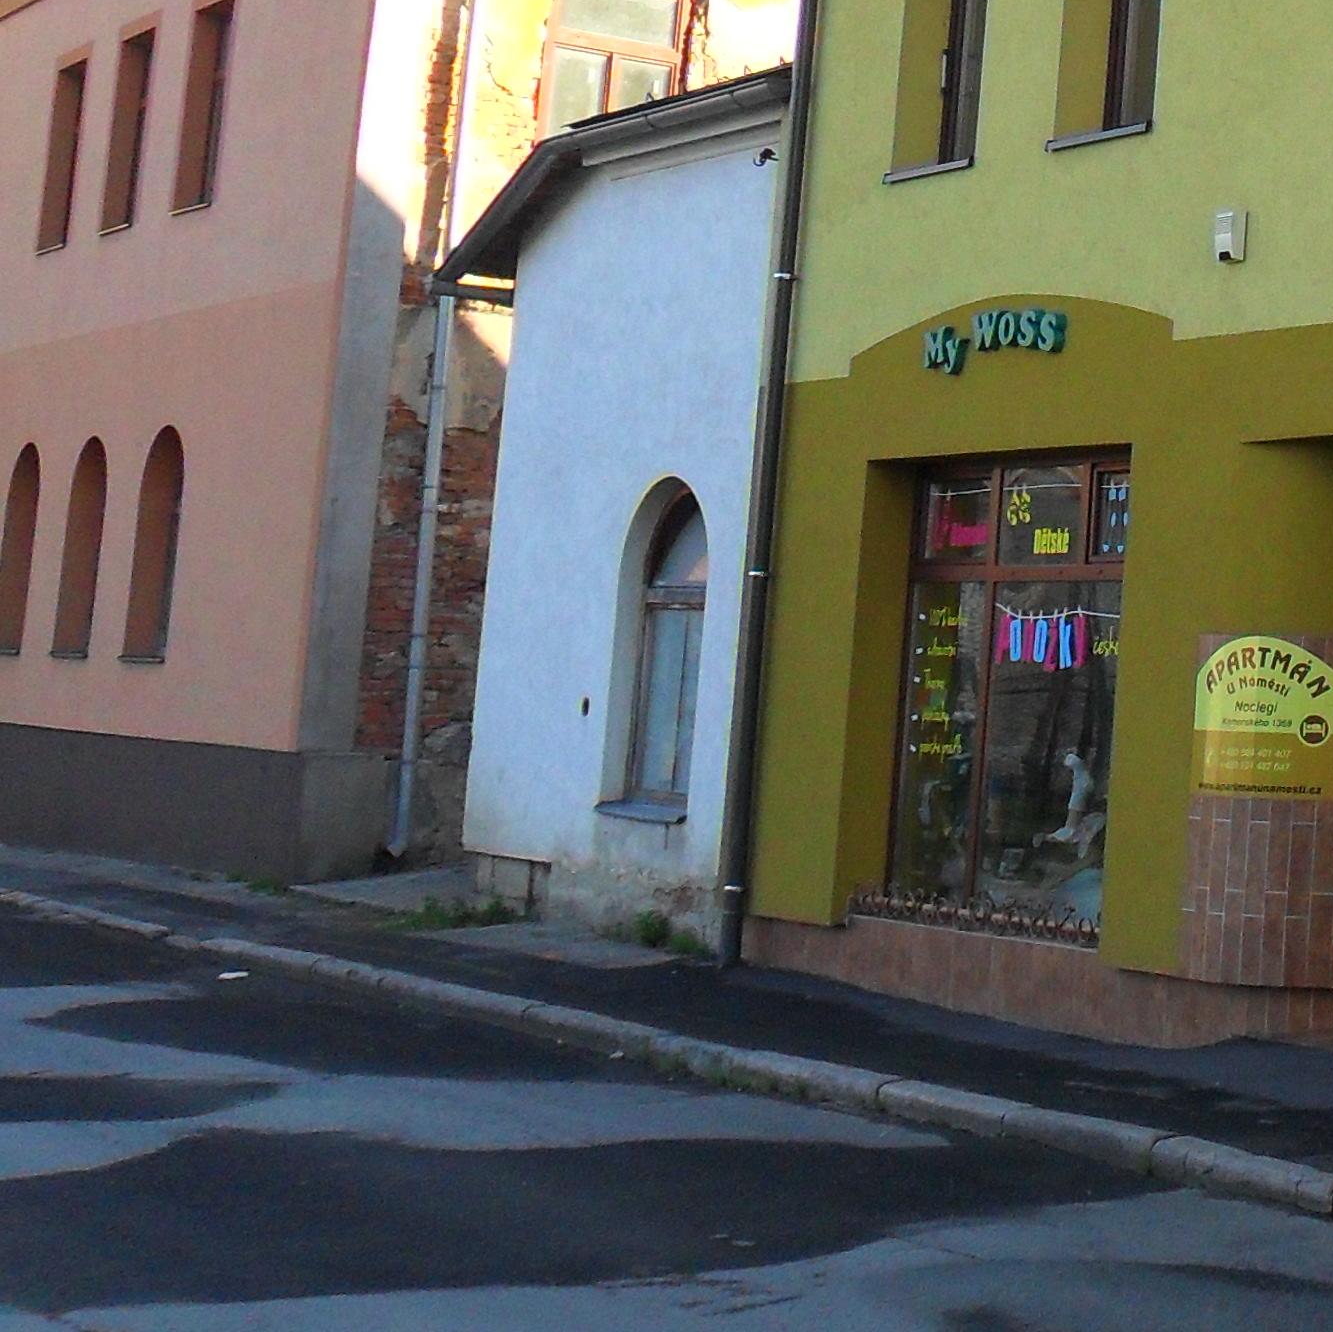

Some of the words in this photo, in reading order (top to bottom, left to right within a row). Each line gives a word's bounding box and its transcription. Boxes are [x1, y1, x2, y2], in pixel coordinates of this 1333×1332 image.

[923, 325, 970, 376] My
[972, 309, 1068, 354] WOSS
[1205, 646, 1331, 699] APARTMÁN
[1234, 700, 1278, 716] Noclegi
